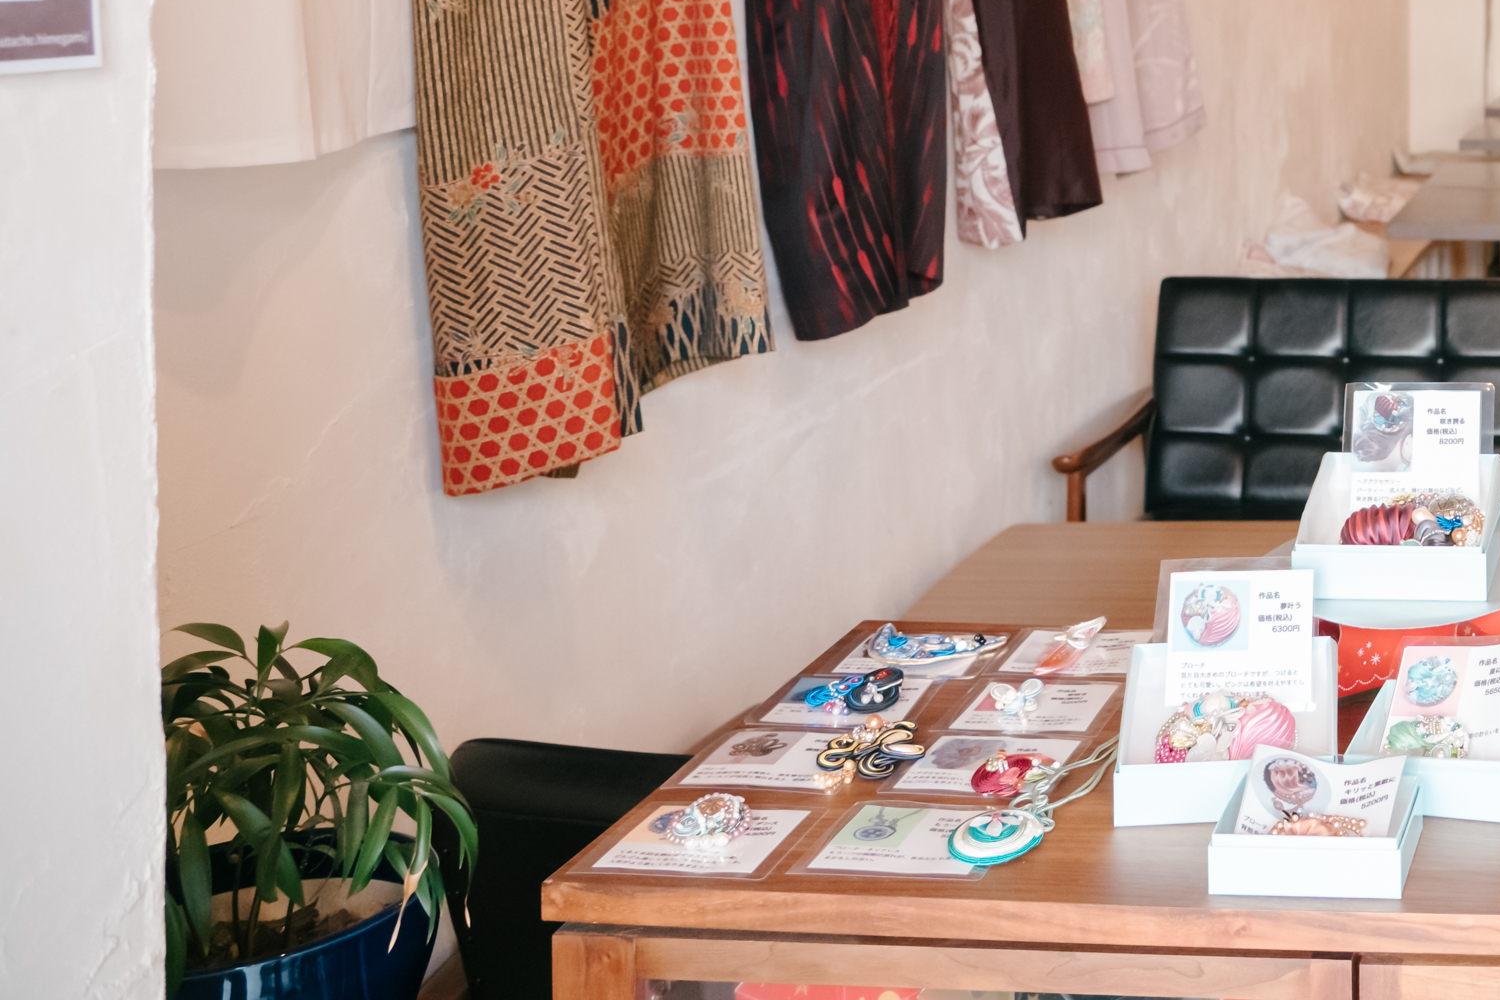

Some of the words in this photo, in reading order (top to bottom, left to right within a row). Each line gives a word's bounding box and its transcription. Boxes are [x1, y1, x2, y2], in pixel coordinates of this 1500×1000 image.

[1258, 591, 1280, 599] 作品名
[1280, 602, 1301, 610] 夢叶う
[1258, 614, 1293, 622] 価格(税込)
[1271, 624, 1300, 632] 6300円
[1479, 658, 1498, 666] 作品名
[1344, 777, 1367, 786] 作品名
[1340, 791, 1376, 805] 価格(税込)
[1360, 795, 1389, 809] 5200円
